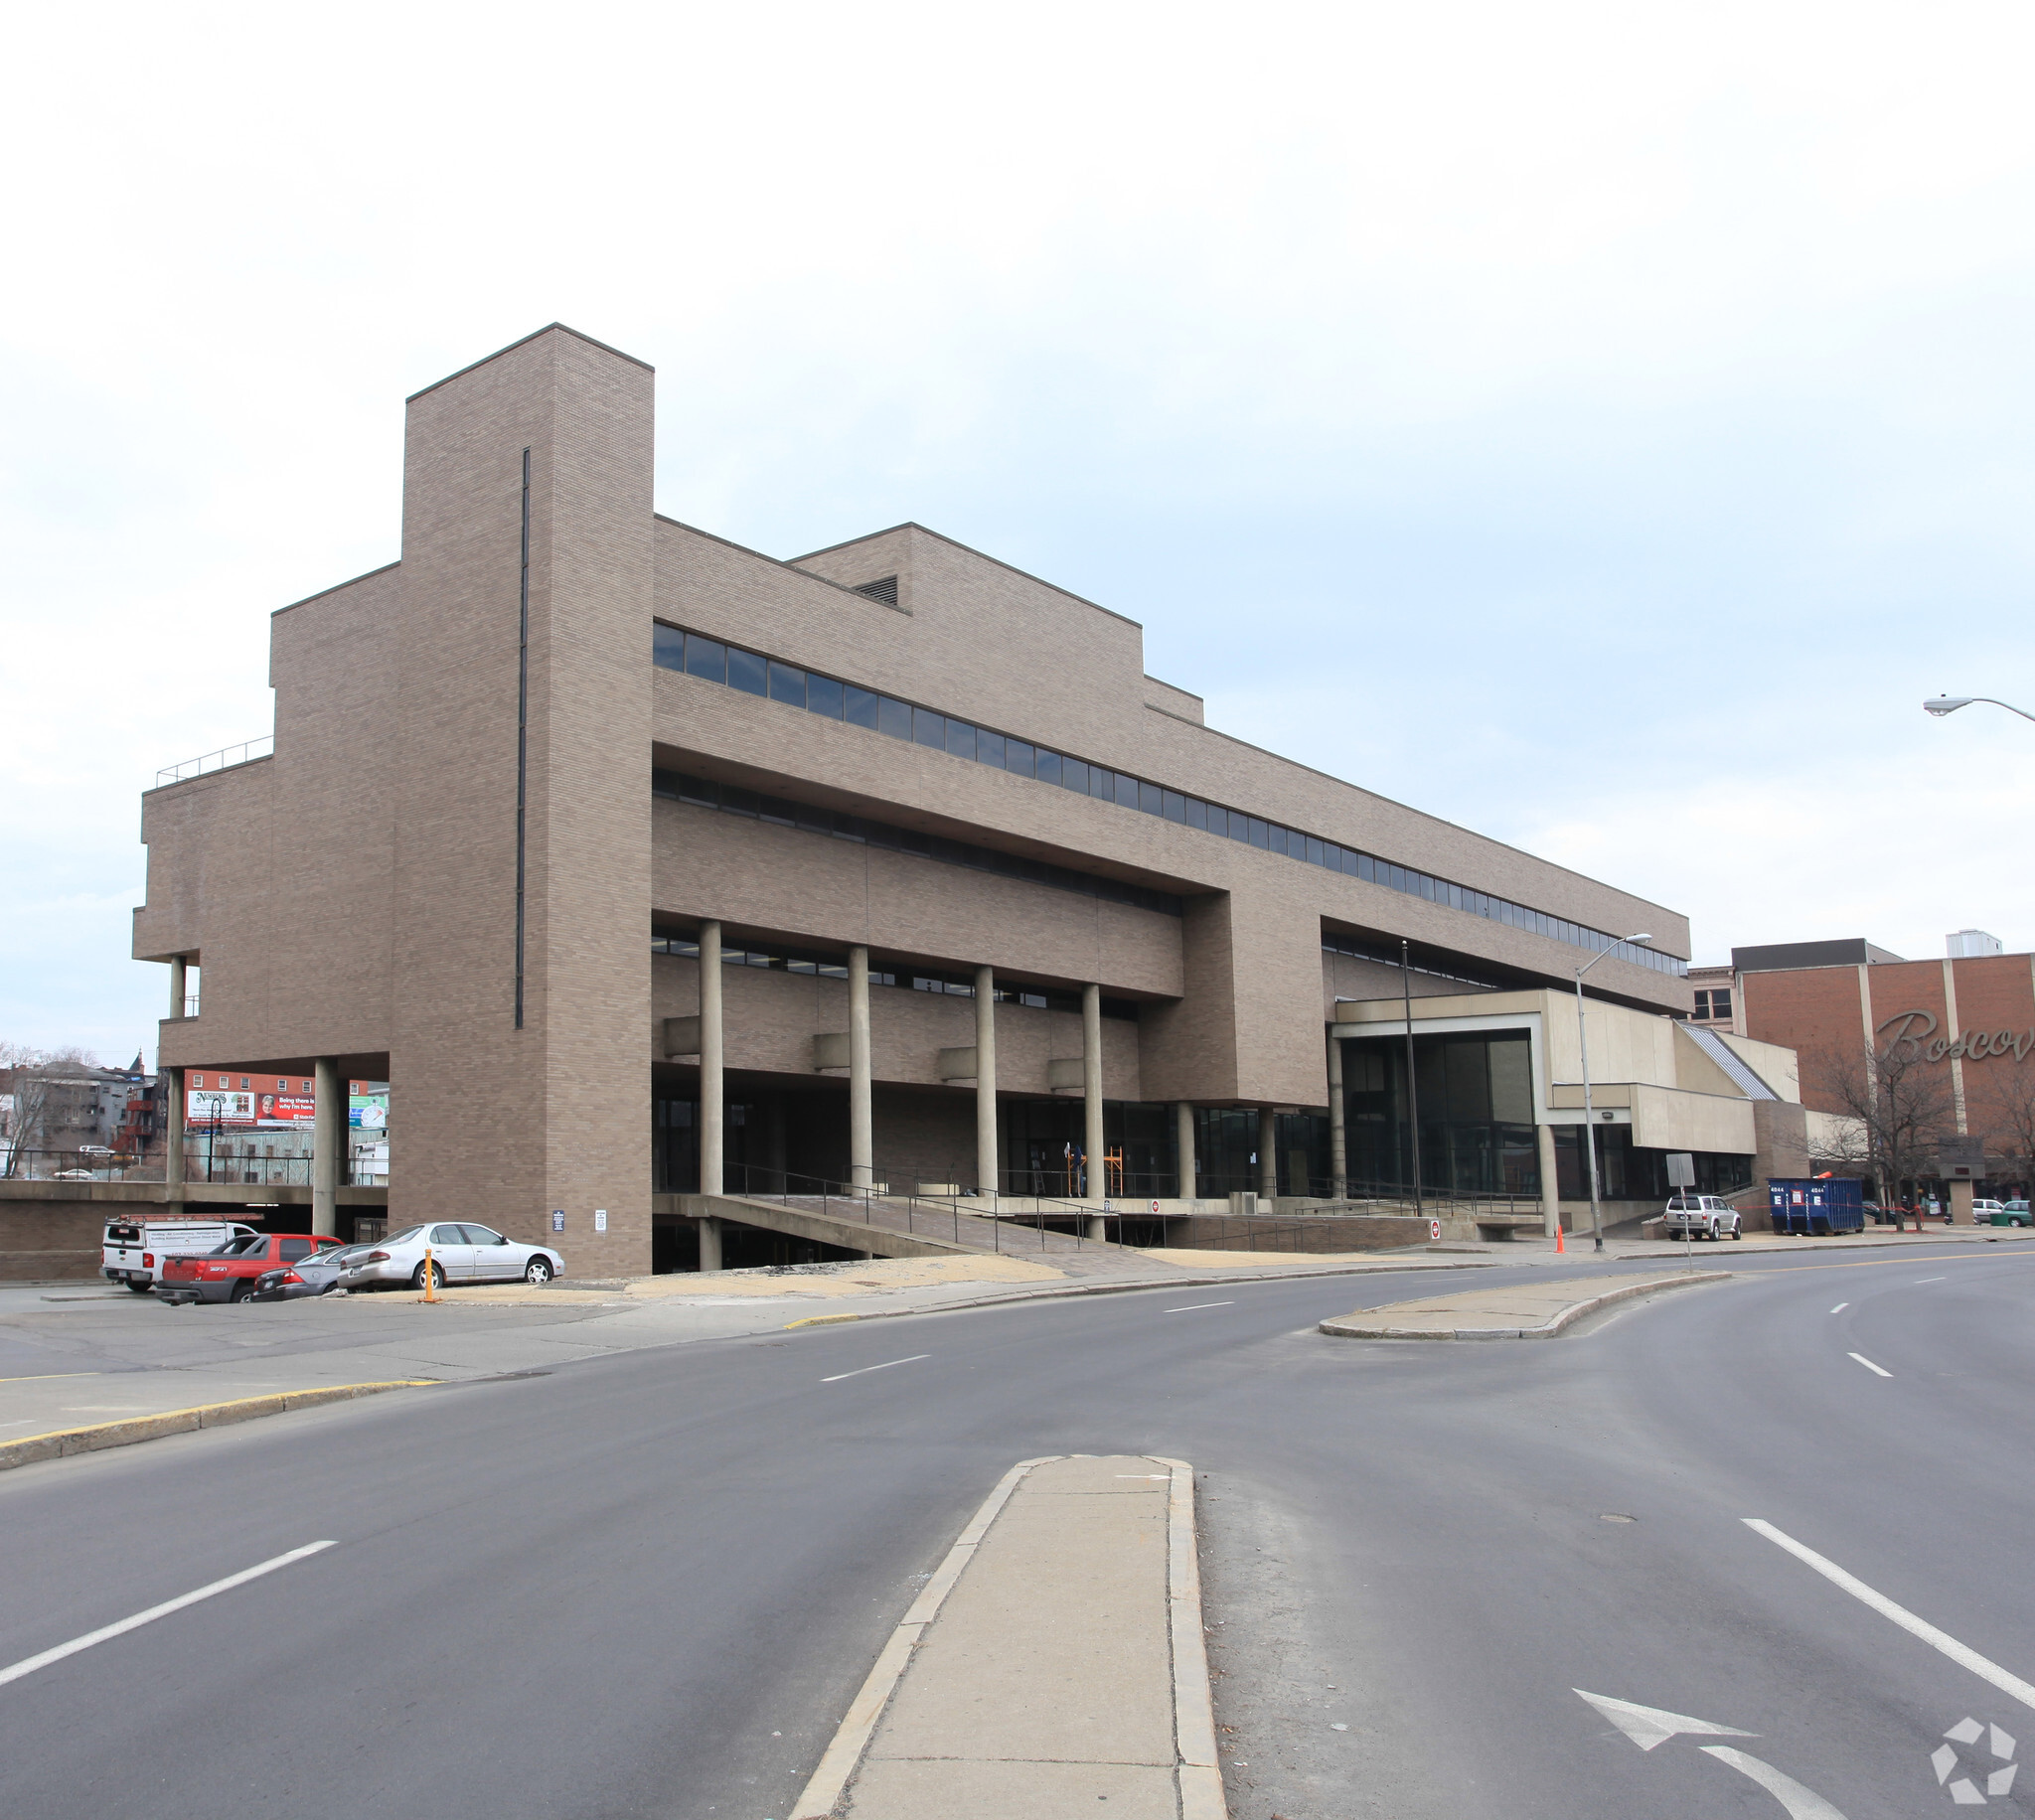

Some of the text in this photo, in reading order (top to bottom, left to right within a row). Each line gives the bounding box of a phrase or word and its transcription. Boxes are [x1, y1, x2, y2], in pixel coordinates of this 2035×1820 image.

[1875, 1008, 2035, 1063] Boscov
[1774, 1195, 1782, 1205] E
[1813, 1195, 1821, 1206] E
